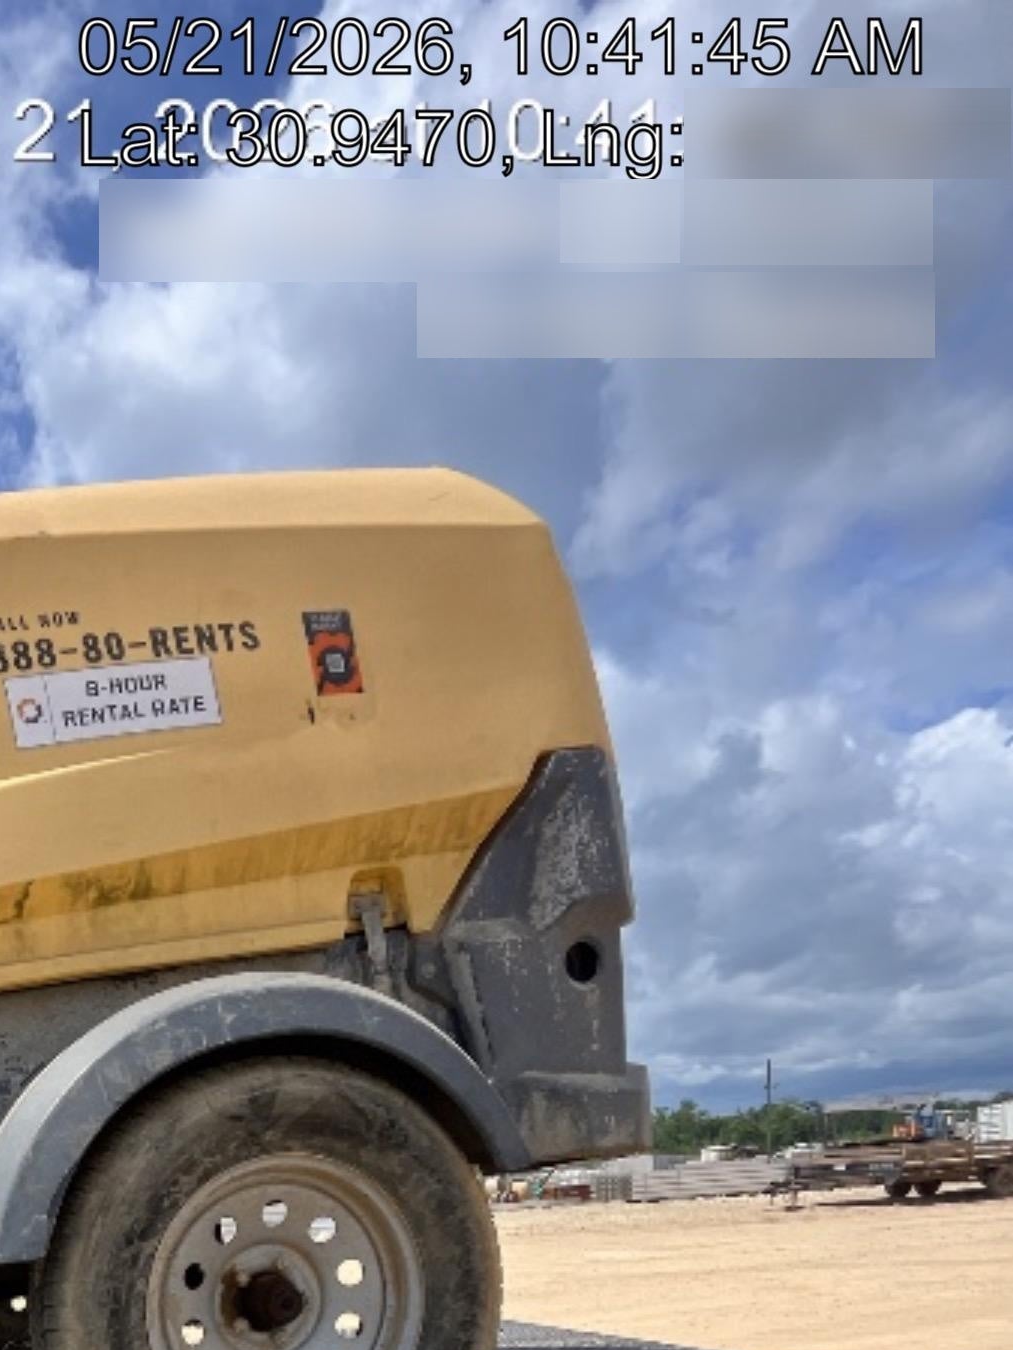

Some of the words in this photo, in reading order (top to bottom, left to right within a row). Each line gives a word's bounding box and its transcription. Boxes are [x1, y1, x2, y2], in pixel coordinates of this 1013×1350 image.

[37, 610, 79, 629] NOW
[85, 673, 167, 697] 8-HOUR
[62, 701, 146, 727] RENTAL
[151, 695, 207, 718] RATE
